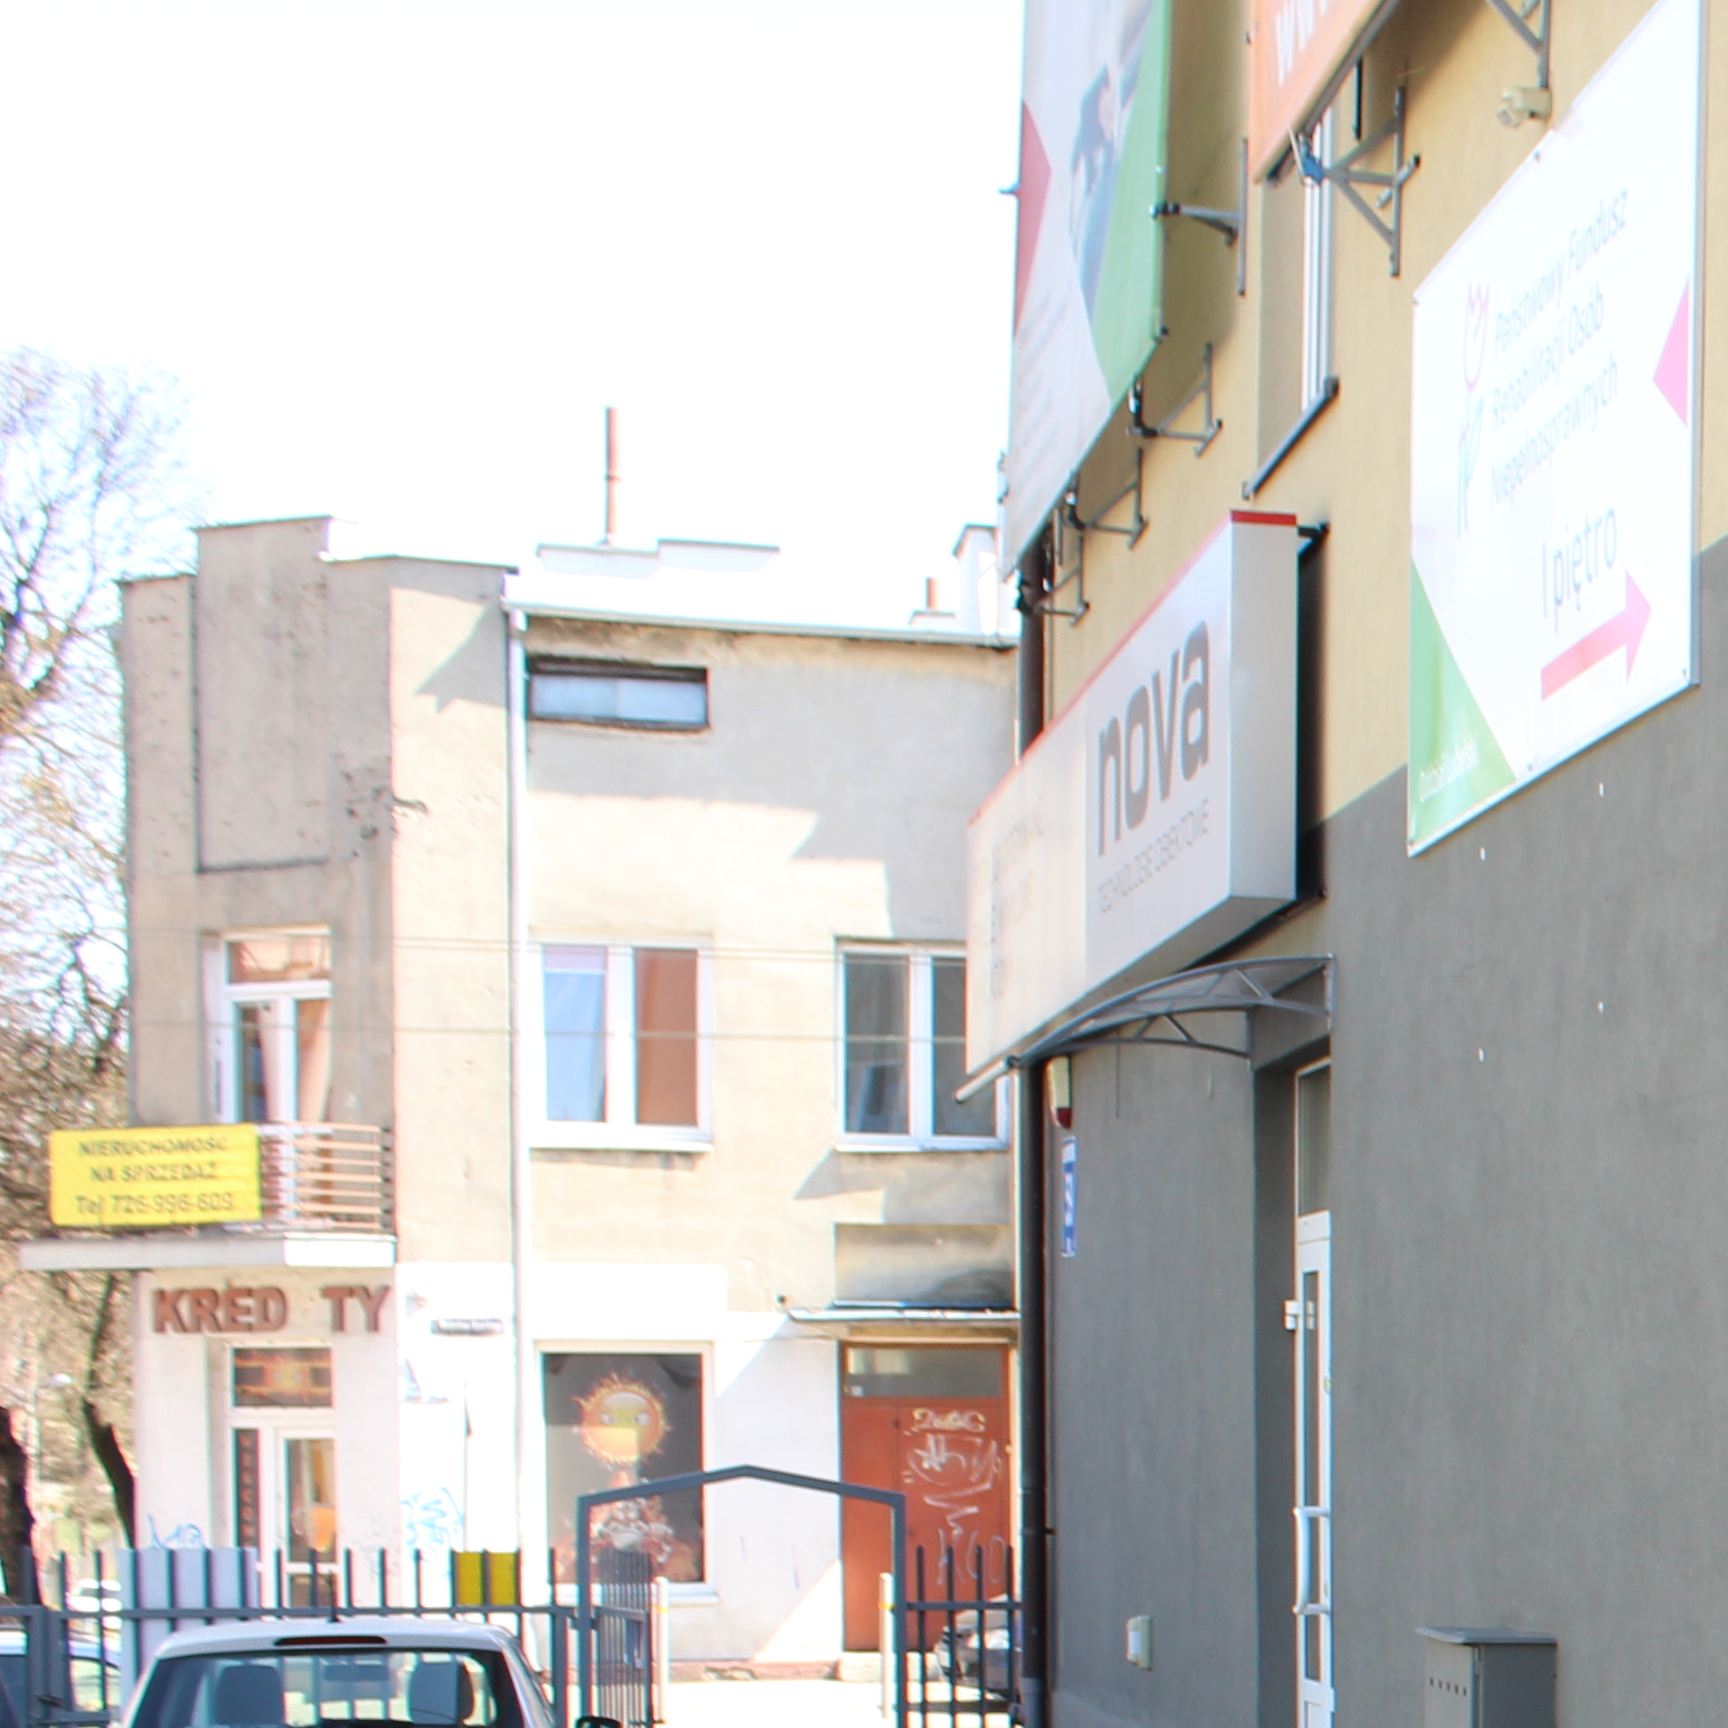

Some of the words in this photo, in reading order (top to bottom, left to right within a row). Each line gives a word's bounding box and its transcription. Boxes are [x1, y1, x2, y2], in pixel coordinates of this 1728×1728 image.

[1568, 188, 1629, 280] Fundusz
[1553, 507, 1618, 634] piętro
[1097, 619, 1211, 858] nova
[91, 1166, 115, 1182] NA
